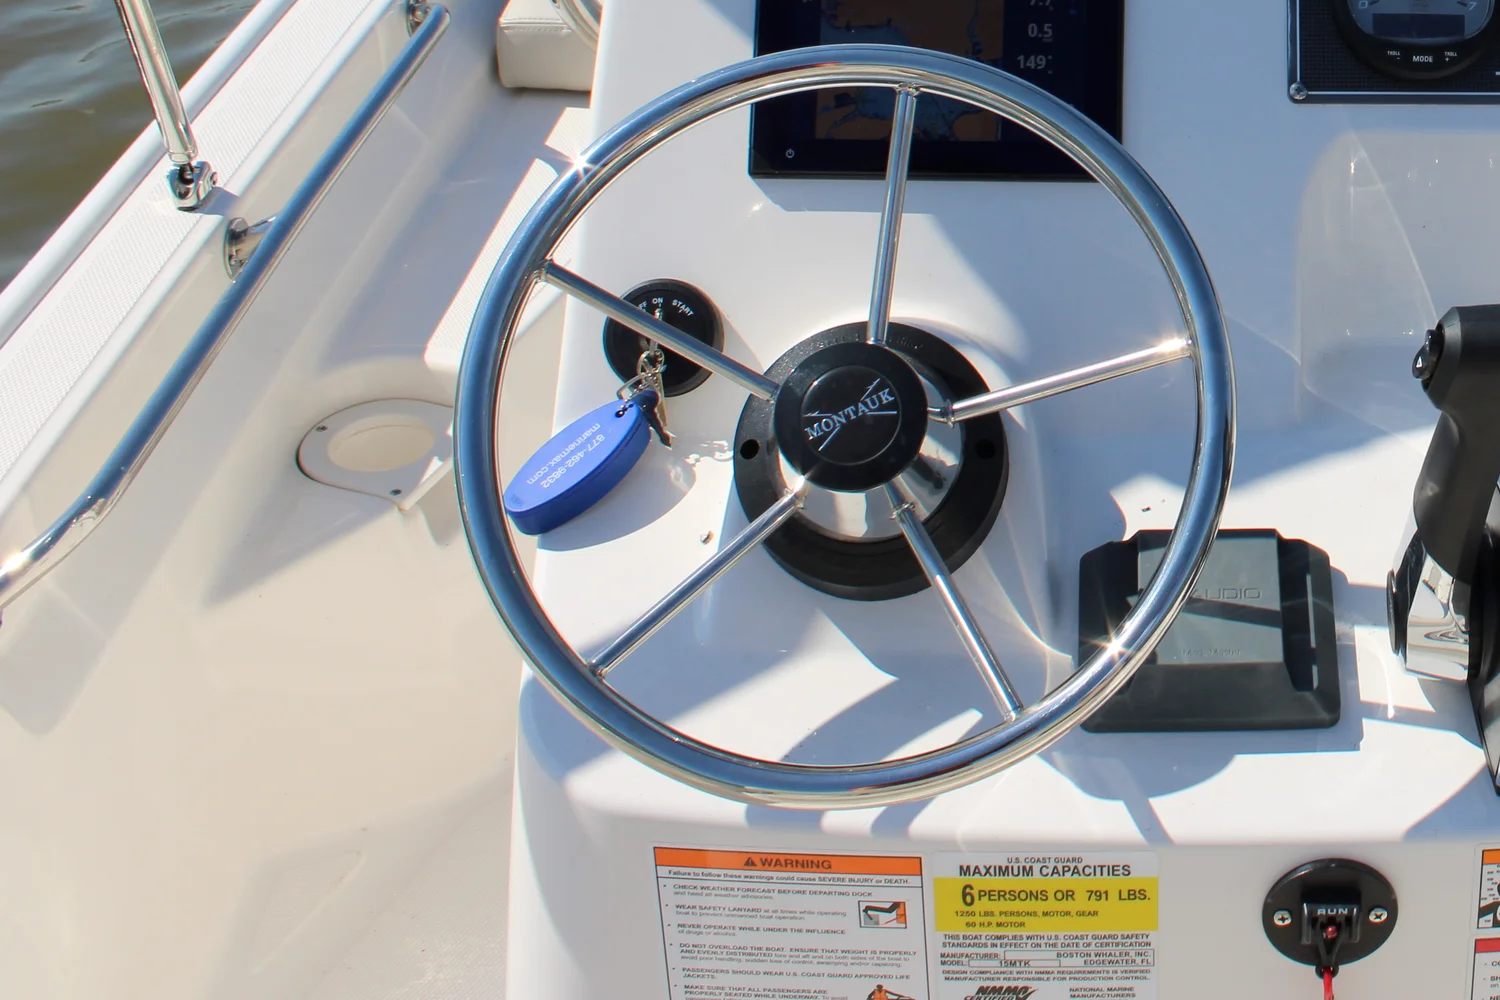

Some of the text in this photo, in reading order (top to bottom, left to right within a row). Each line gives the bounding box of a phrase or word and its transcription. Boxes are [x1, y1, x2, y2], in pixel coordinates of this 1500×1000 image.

[1358, 0, 1368, 9] 0
[1468, 2, 1477, 11] 7
[1027, 23, 1053, 37] 0.5
[672, 299, 694, 316] START
[804, 388, 895, 440] MONTAUK
[527, 423, 601, 486] marinemax.com
[760, 858, 832, 870] WARNING
[1008, 856, 1083, 864] U.S. COAST GUARD
[959, 864, 1131, 876] MAXIMUM CAPACITIES
[700, 884, 734, 892] WEATHER
[737, 886, 776, 894] FORECAST
[962, 884, 1150, 907] 6 PERSONS OR 791 LBS.
[999, 910, 1040, 918] PERSONS,
[1042, 910, 1074, 918] MOTOR,
